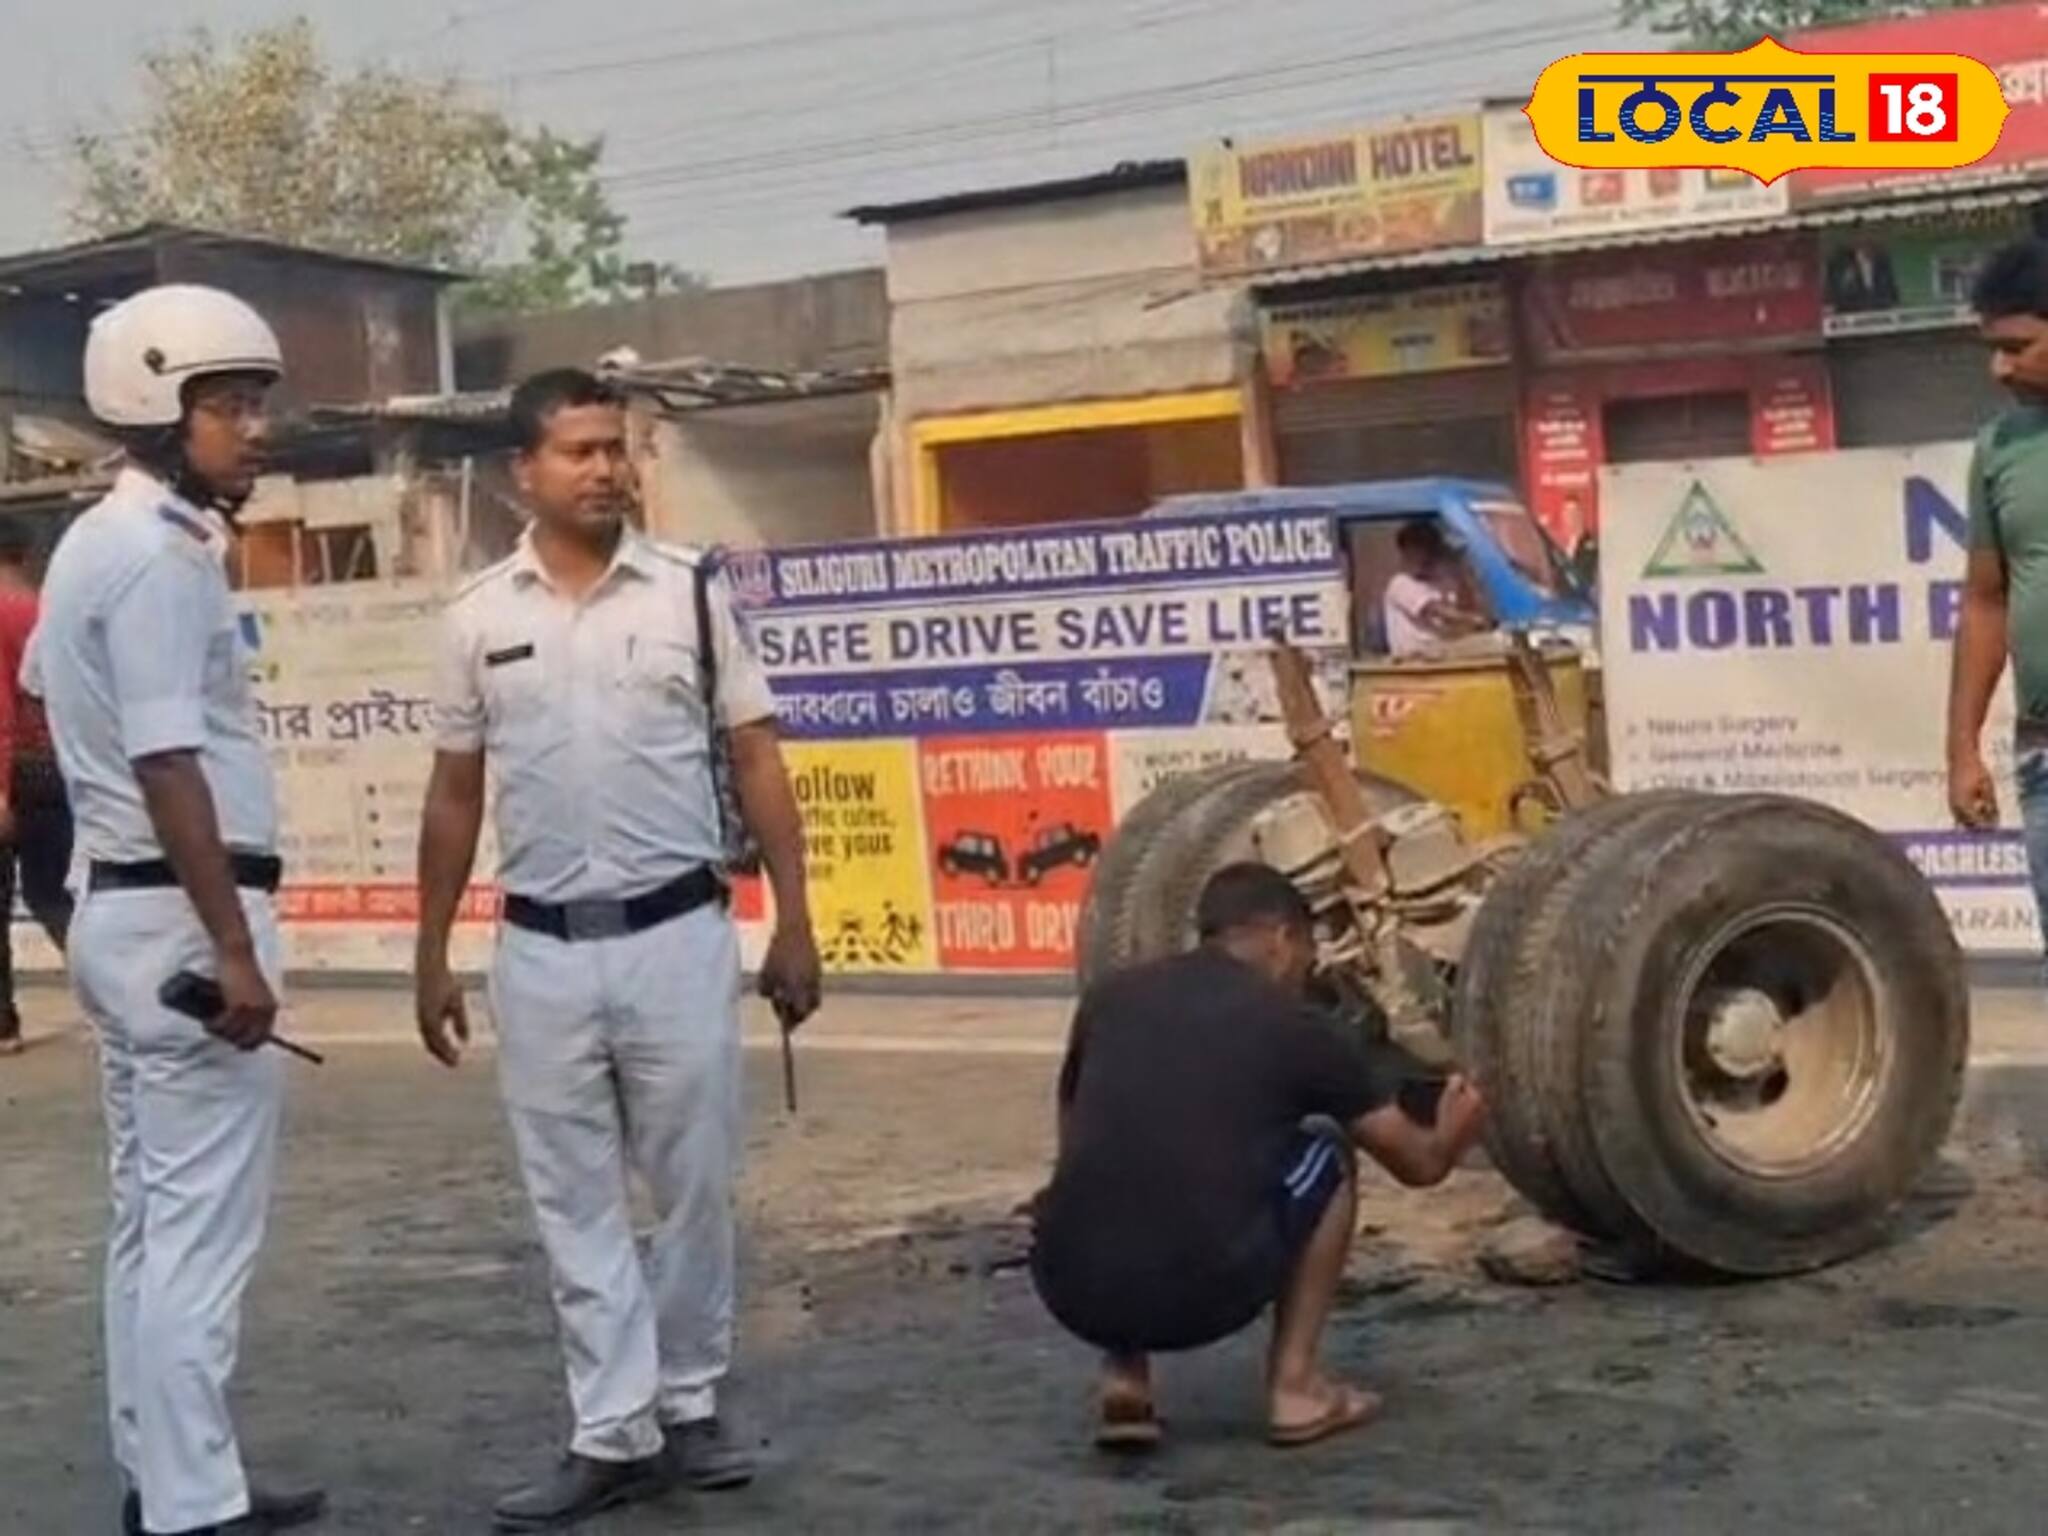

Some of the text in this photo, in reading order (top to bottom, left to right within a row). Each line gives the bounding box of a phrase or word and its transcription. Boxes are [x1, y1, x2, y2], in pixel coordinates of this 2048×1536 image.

[1371, 124, 1474, 179] HOTEL
[777, 552, 889, 597] SILIGURI
[892, 536, 1097, 588] METROPOLITAN
[1102, 526, 1221, 574] TRAFFIC
[1224, 516, 1332, 566] POLICE
[760, 622, 871, 667] SAFE
[889, 612, 1039, 660] DRIVE
[1056, 602, 1189, 651] SAVE
[1629, 583, 1901, 652] NORTH
[888, 686, 975, 722] চালাও
[985, 668, 1069, 718] জীবন
[1078, 666, 1164, 715] বাঁচাও
[796, 765, 875, 802] ollow
